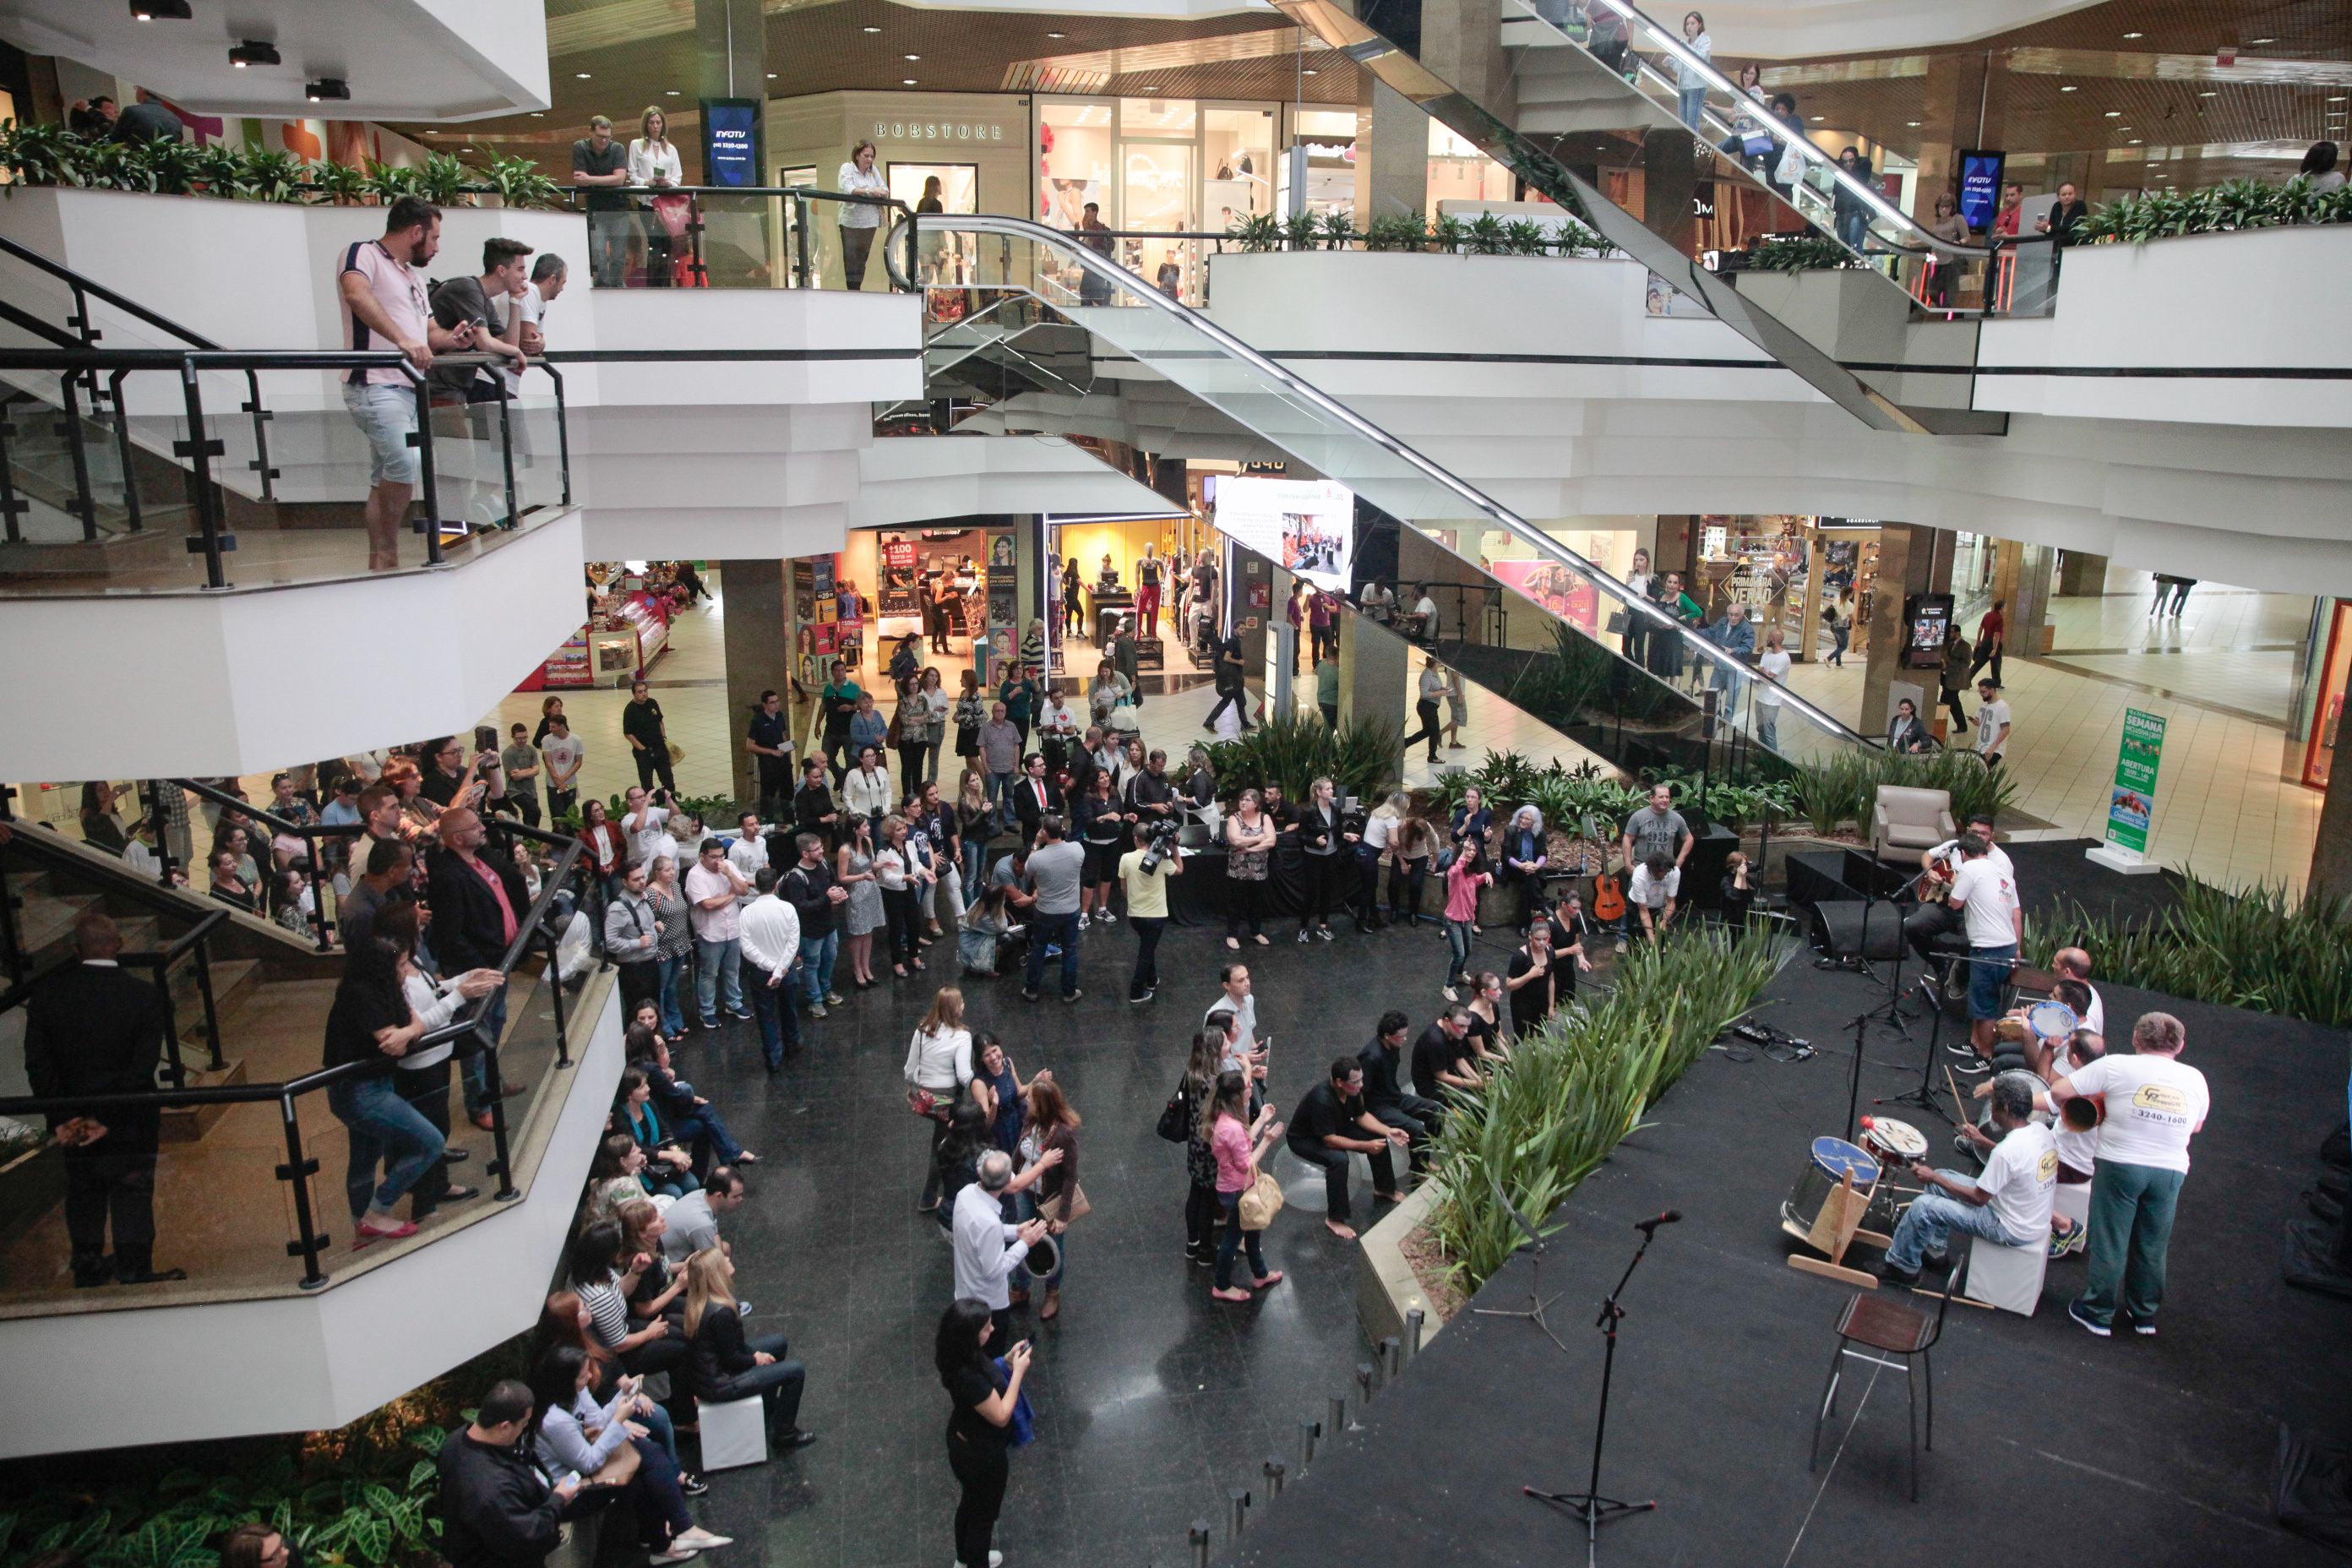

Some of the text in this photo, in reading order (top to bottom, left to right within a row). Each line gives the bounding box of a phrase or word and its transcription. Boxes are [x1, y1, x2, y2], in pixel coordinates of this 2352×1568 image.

[875, 123, 1002, 139] BOBSTORE
[2126, 715, 2163, 733] SEMANA
[2121, 758, 2154, 775] ABERTURA
[2137, 1109, 2187, 1124] 3240-1600
